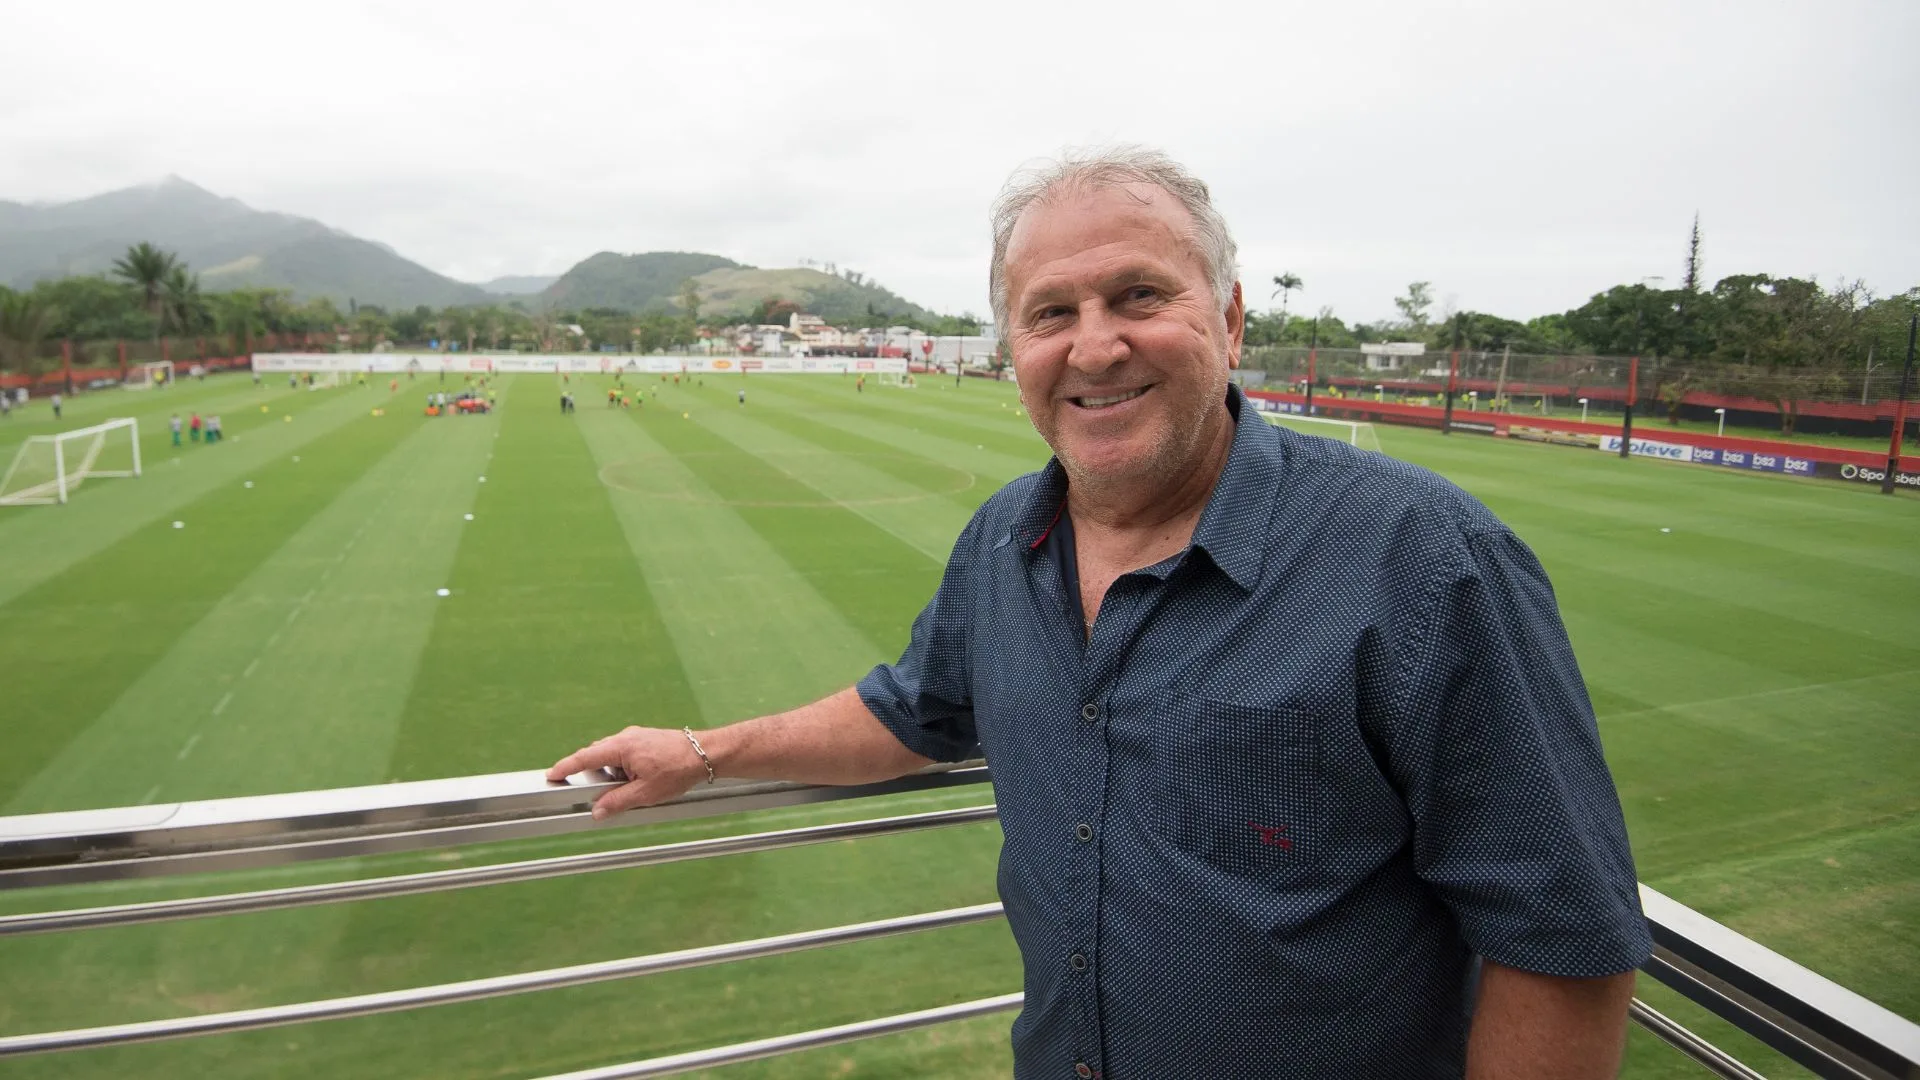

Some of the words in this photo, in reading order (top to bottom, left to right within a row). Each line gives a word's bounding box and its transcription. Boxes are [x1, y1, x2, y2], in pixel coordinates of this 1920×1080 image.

[1608, 438, 1682, 458] boleve
[1693, 446, 1715, 460] bs2
[1722, 449, 1744, 463] bs2
[1752, 452, 1776, 467] bs2
[1784, 455, 1808, 471] bs2
